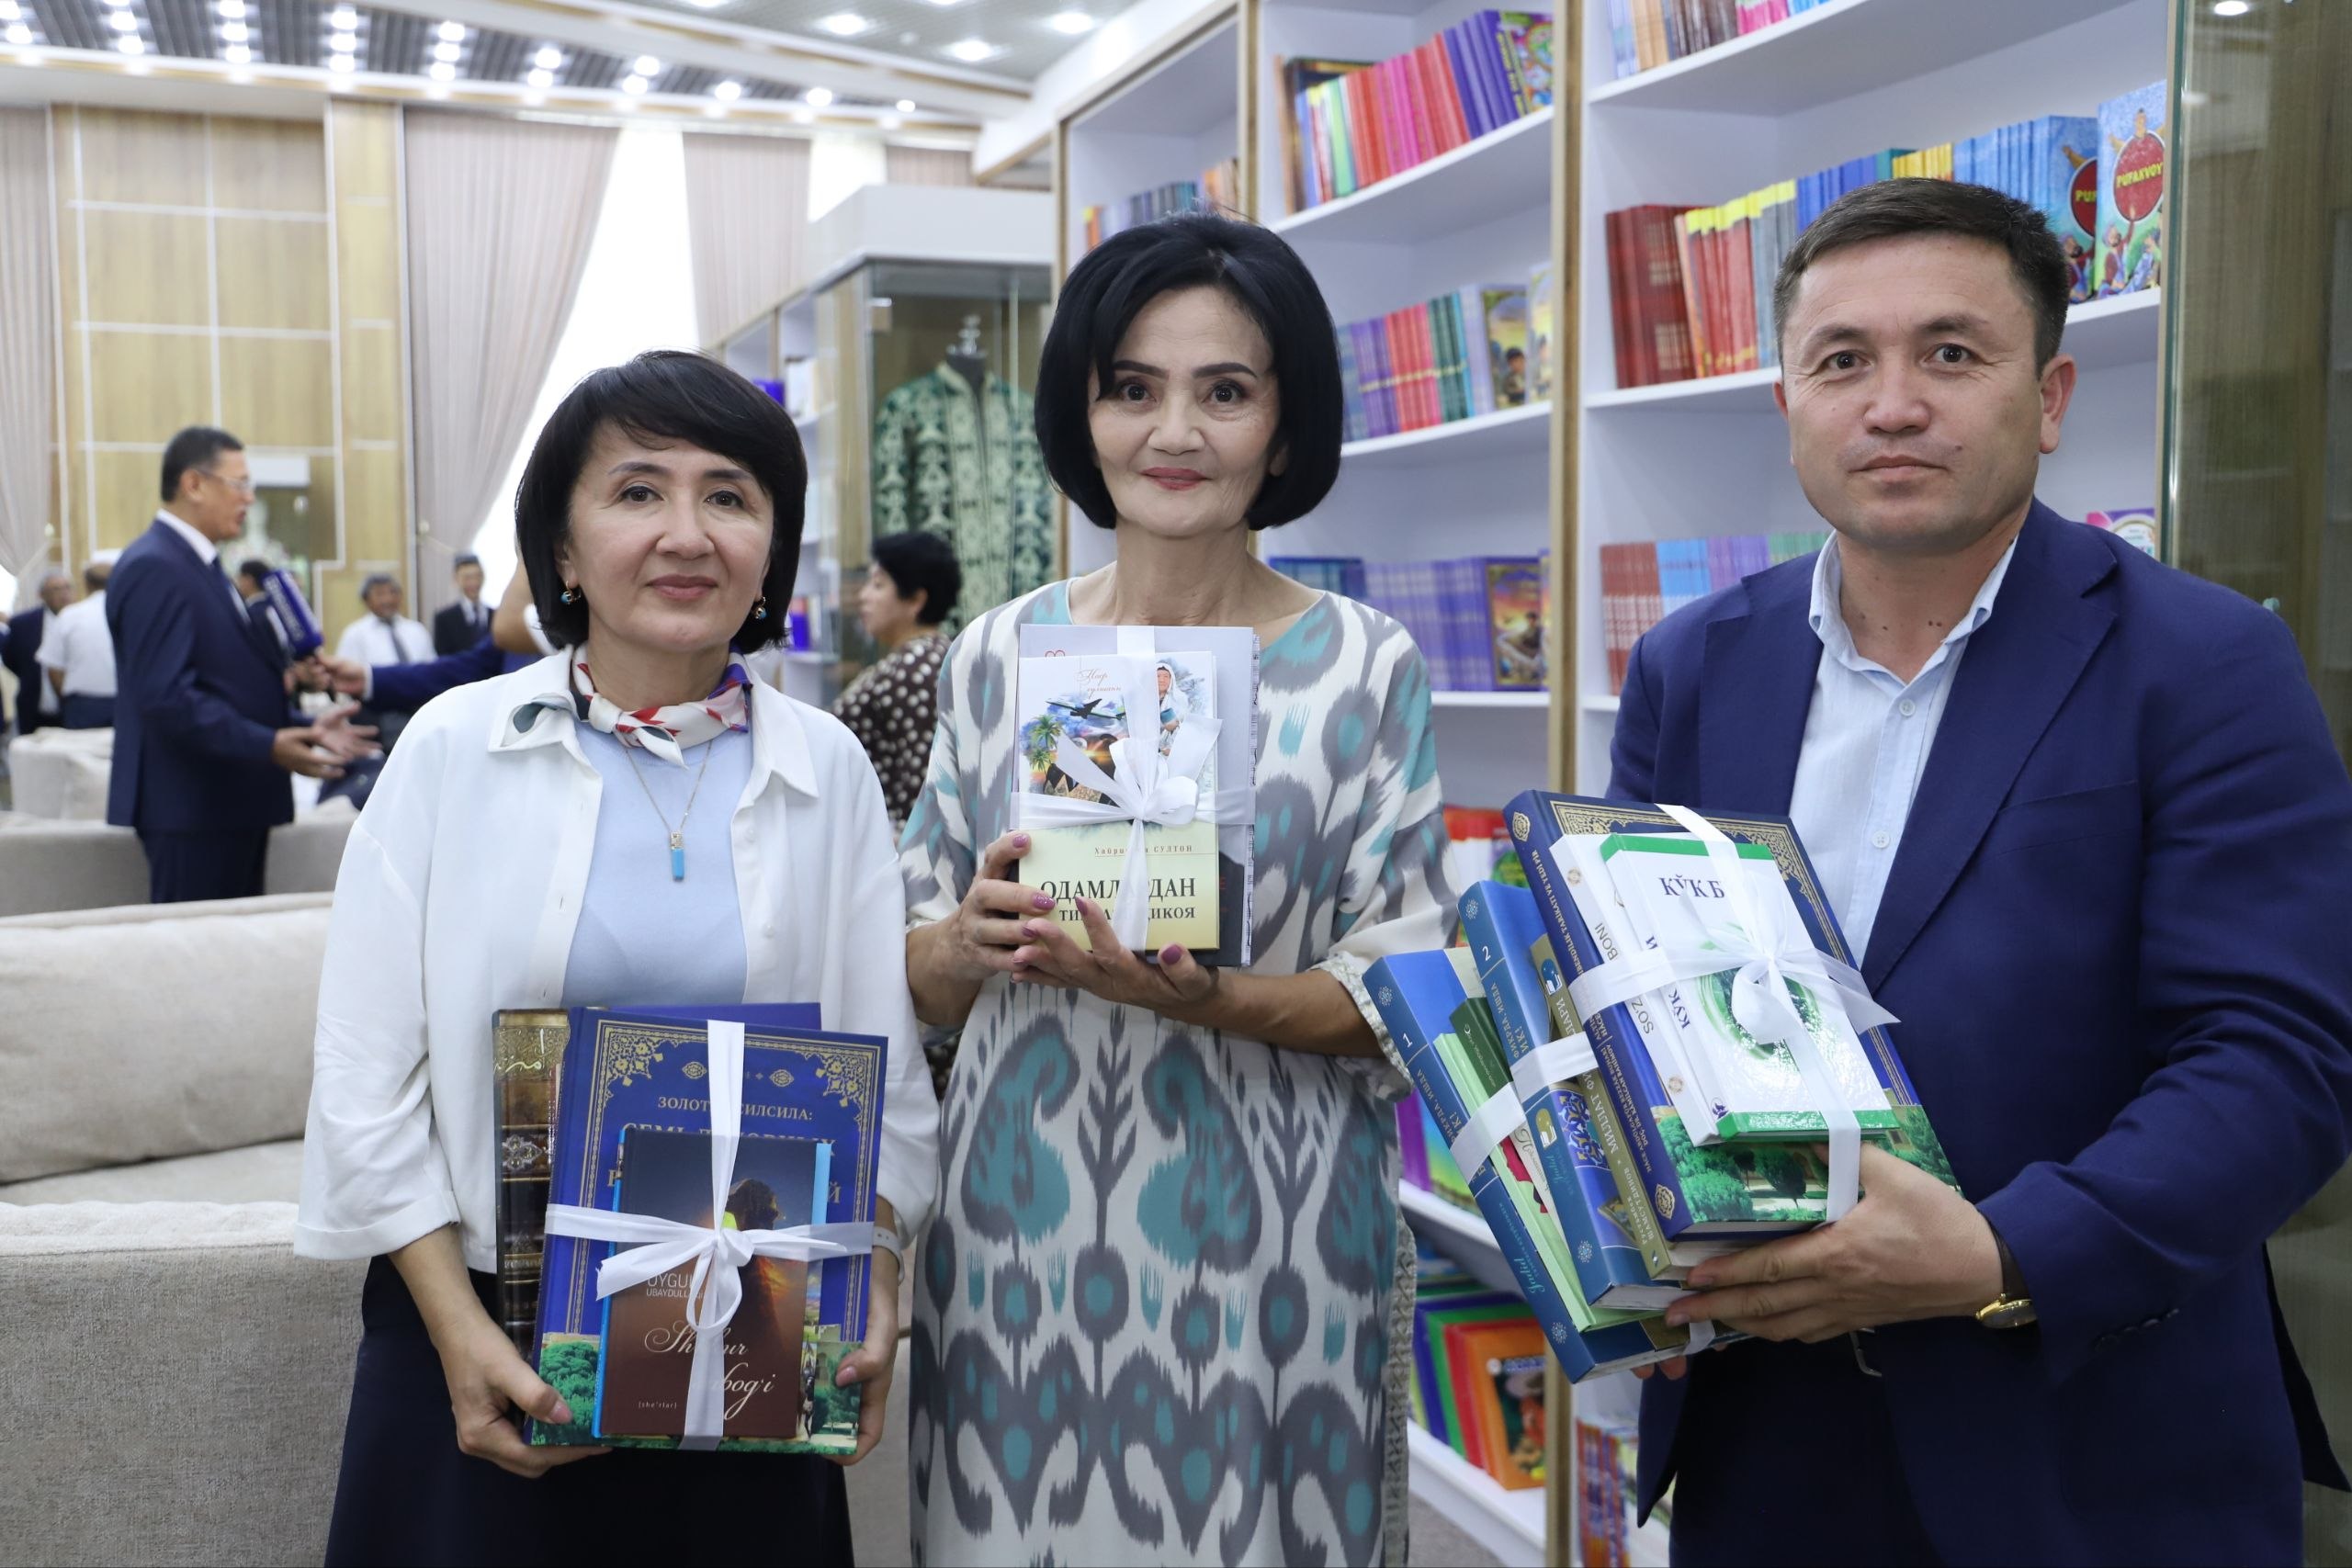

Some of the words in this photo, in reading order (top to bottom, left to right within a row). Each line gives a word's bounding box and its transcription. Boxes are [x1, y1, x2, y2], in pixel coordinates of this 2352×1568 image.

[1041, 878, 1196, 904] ОДАМЛДАН
[1148, 907, 1196, 921] ИКОЯ
[1489, 982, 1505, 1012] ИШДА
[658, 1096, 710, 1113] ЗОЛОТ
[741, 1104, 813, 1122] ИЛСИЛА:
[1589, 1092, 1619, 1154] МИЛЛАТ
[1512, 1252, 1545, 1297] Jadid
